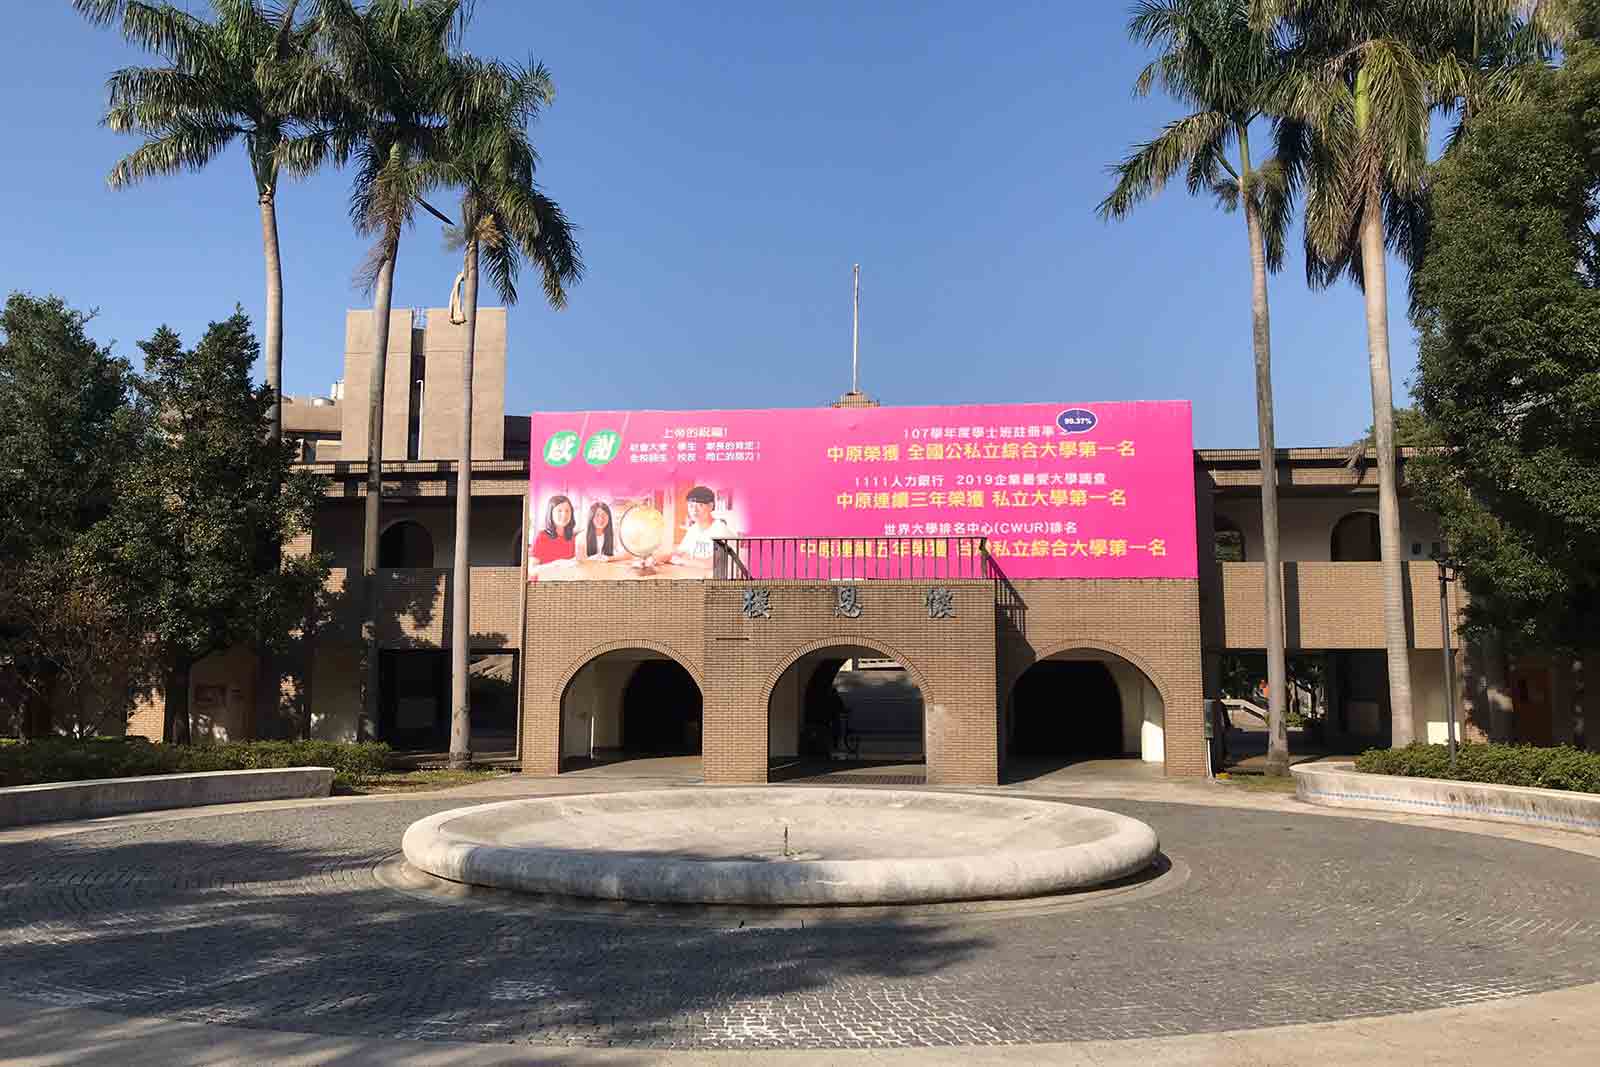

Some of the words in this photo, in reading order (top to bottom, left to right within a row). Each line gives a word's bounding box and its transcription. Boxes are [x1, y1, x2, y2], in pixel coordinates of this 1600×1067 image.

[546, 434, 615, 463] 感謝
[827, 444, 900, 464] 中原榮獲
[908, 440, 1136, 461] 全國公私立綜合大學第一名
[836, 492, 985, 510] 中原連續三年榮獲
[992, 490, 1127, 507] 私立大學第一名
